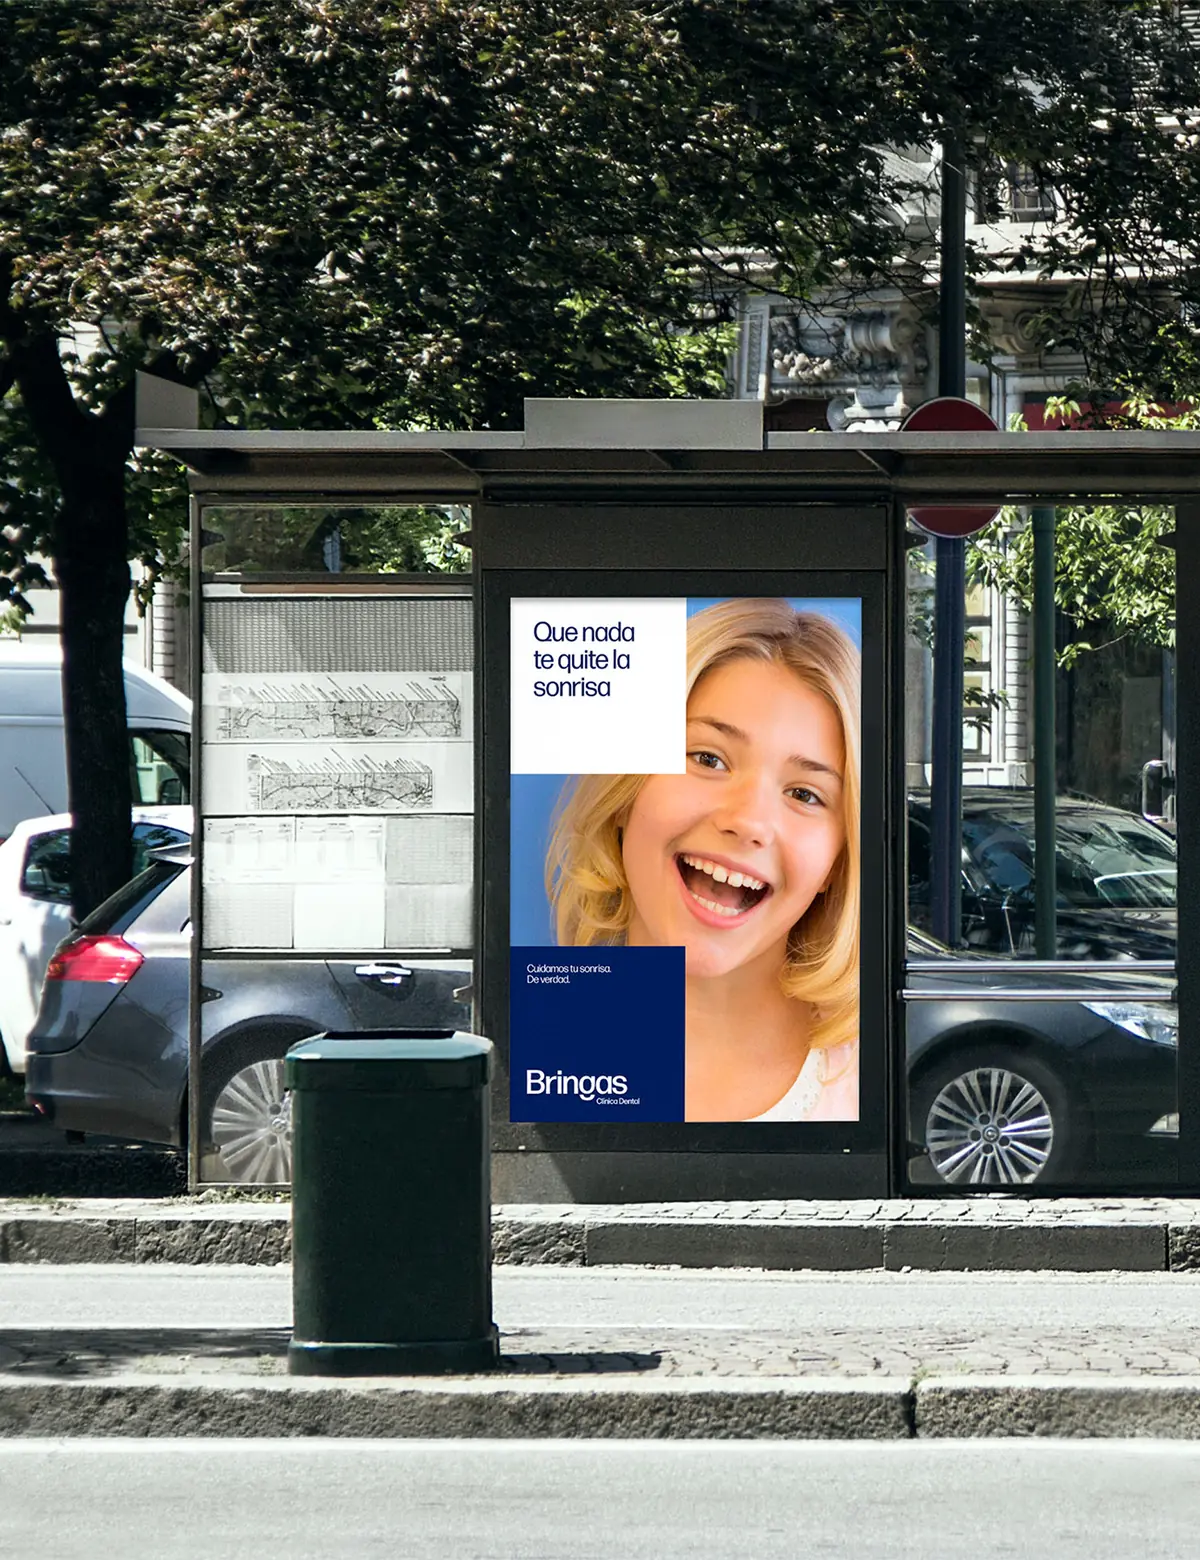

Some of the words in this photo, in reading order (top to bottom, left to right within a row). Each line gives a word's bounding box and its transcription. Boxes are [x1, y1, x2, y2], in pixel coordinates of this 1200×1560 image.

[534, 621, 578, 642] Que
[582, 621, 635, 642] nada
[534, 650, 554, 669] te
[558, 650, 609, 674] quite
[613, 649, 630, 669] la
[534, 677, 611, 697] sonrisa
[526, 963, 569, 974] Cuidamos
[570, 965, 579, 973] tu
[579, 964, 612, 973] sonrisa.
[526, 974, 540, 984] De
[540, 974, 570, 984] verdad.
[526, 1069, 629, 1101] Bringas
[619, 1097, 641, 1106] Dental
